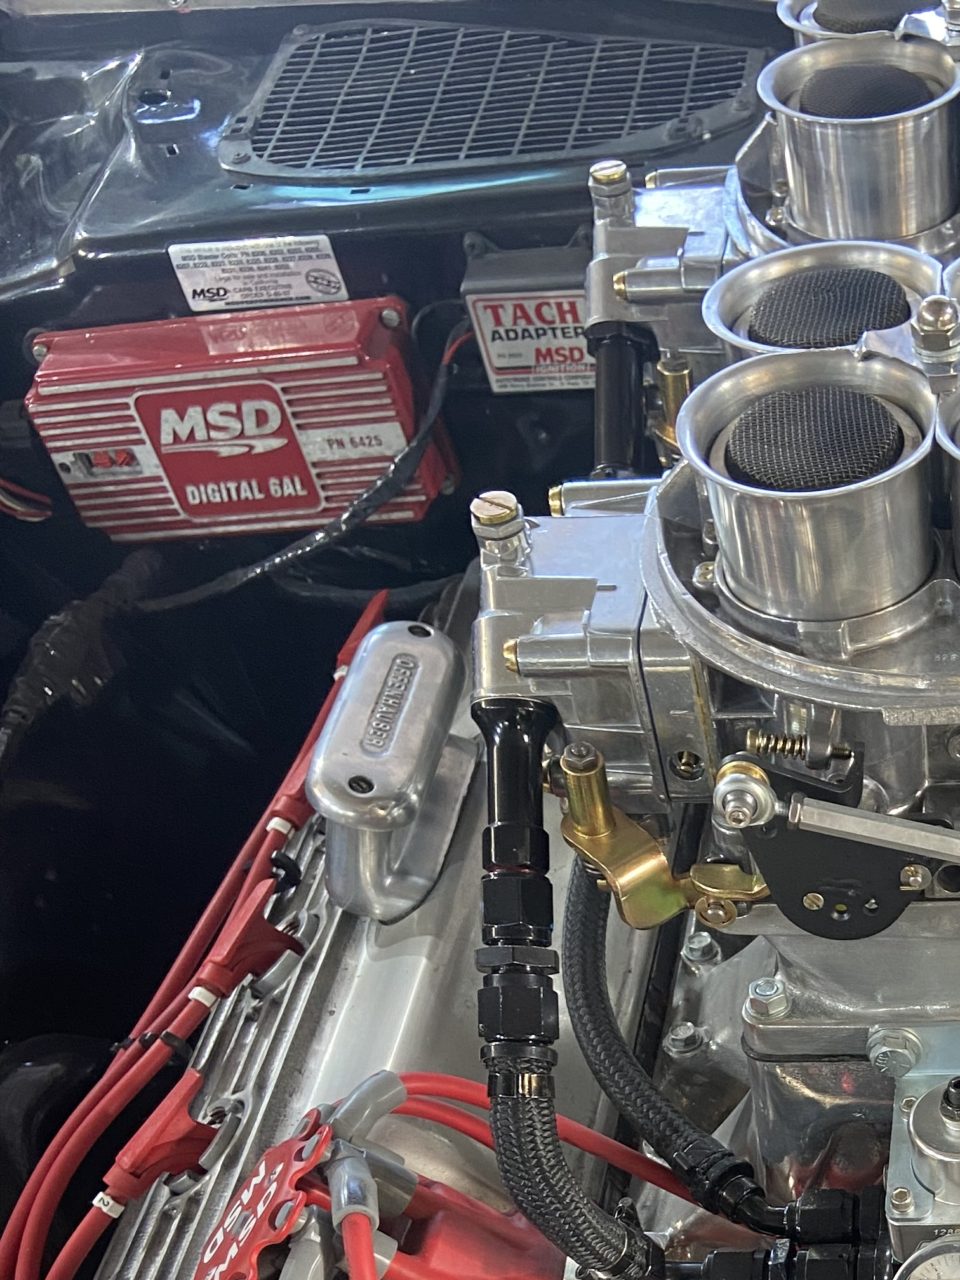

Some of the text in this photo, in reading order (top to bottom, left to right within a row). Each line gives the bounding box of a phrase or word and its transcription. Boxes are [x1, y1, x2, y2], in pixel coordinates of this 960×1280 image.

[191, 287, 228, 300] MSD
[482, 301, 582, 328] TACH
[535, 346, 584, 364] MSD
[160, 400, 282, 444] MSD
[327, 434, 383, 450] PN 6425
[185, 475, 308, 505] DIGITAL 6AL
[99, 1196, 110, 1207] 2
